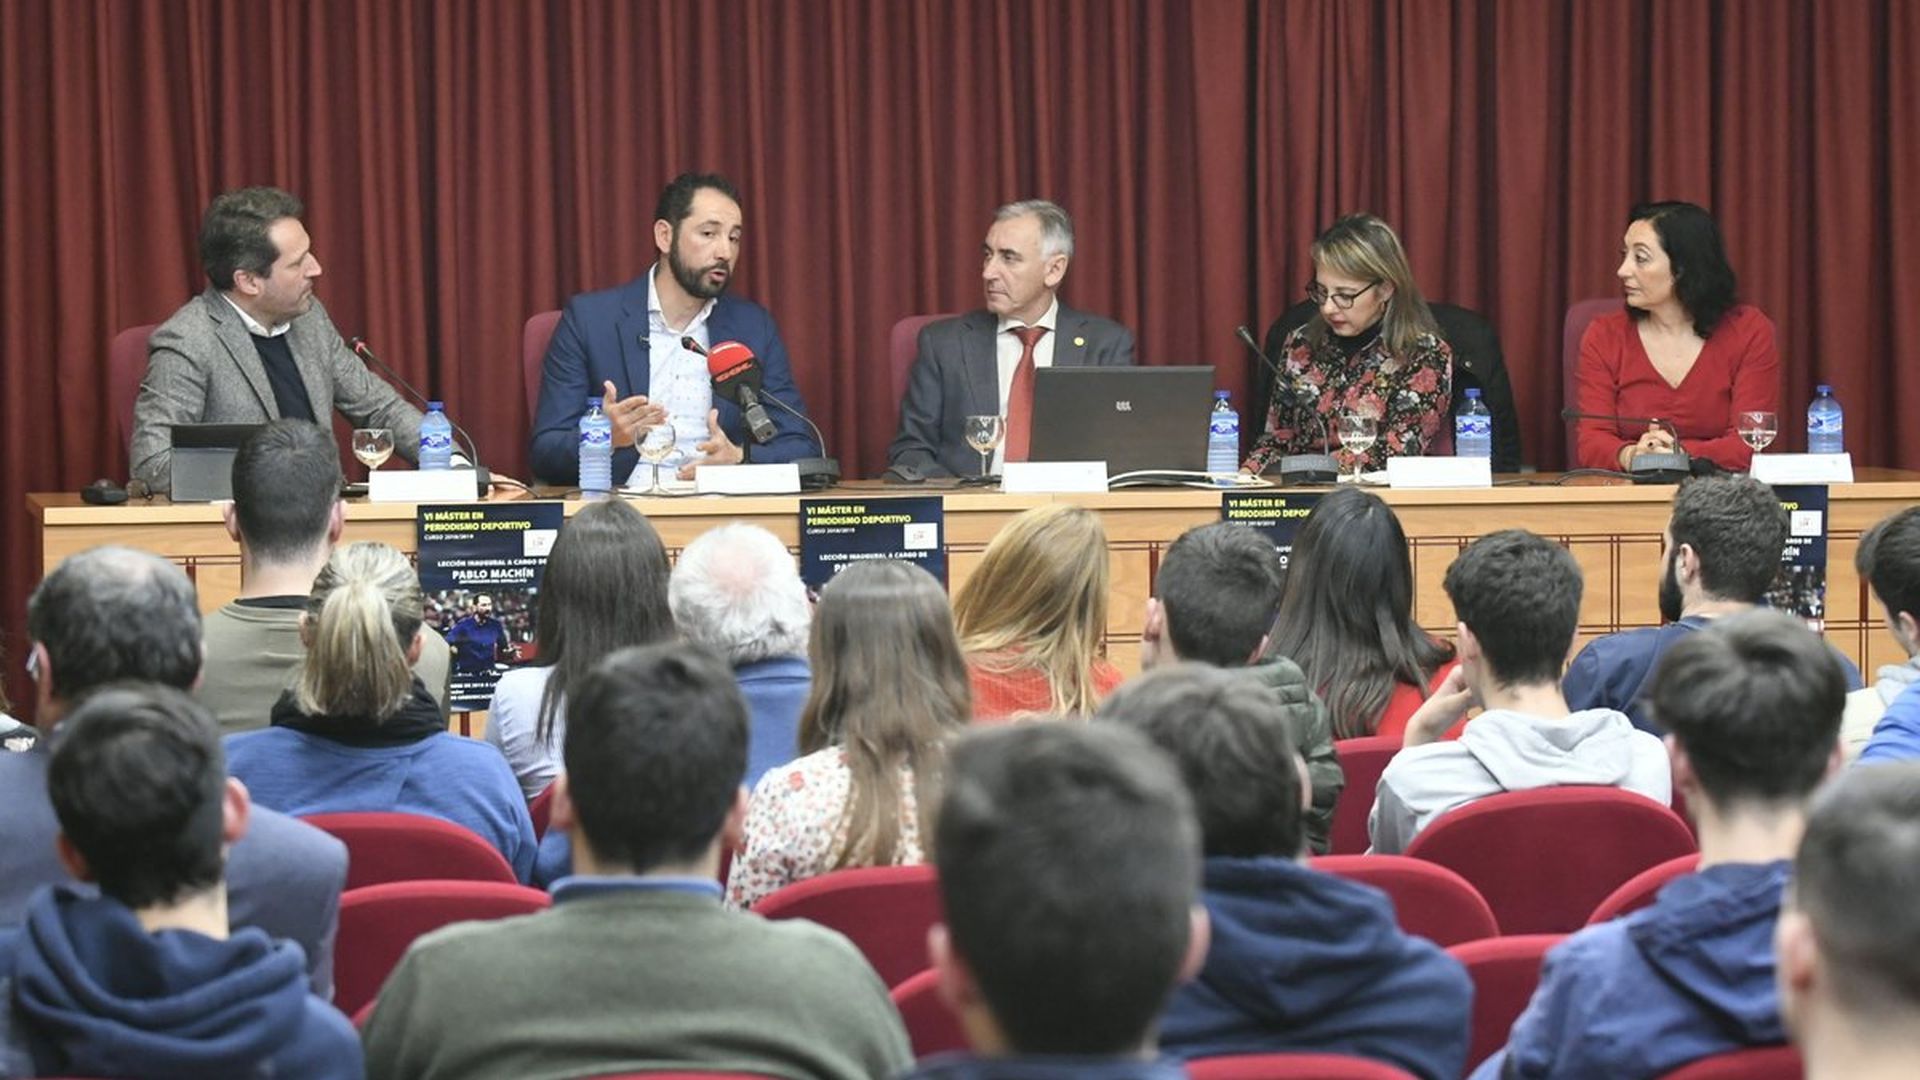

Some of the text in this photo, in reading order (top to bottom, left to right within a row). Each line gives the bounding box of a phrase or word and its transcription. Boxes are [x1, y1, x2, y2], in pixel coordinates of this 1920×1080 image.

[1239, 498, 1273, 507] MÁSTER
[806, 505, 865, 515] VI MÁSTER EN
[1228, 509, 1281, 518] PERIODISMO
[424, 511, 484, 520] VI MÁSTER EN
[807, 515, 911, 525] PERIODISMO DEPORTIVO
[424, 521, 531, 532] PERIODISMO DEPORTIVO
[894, 551, 917, 559] CARGO
[452, 567, 534, 580] PABLO MACHÍN
